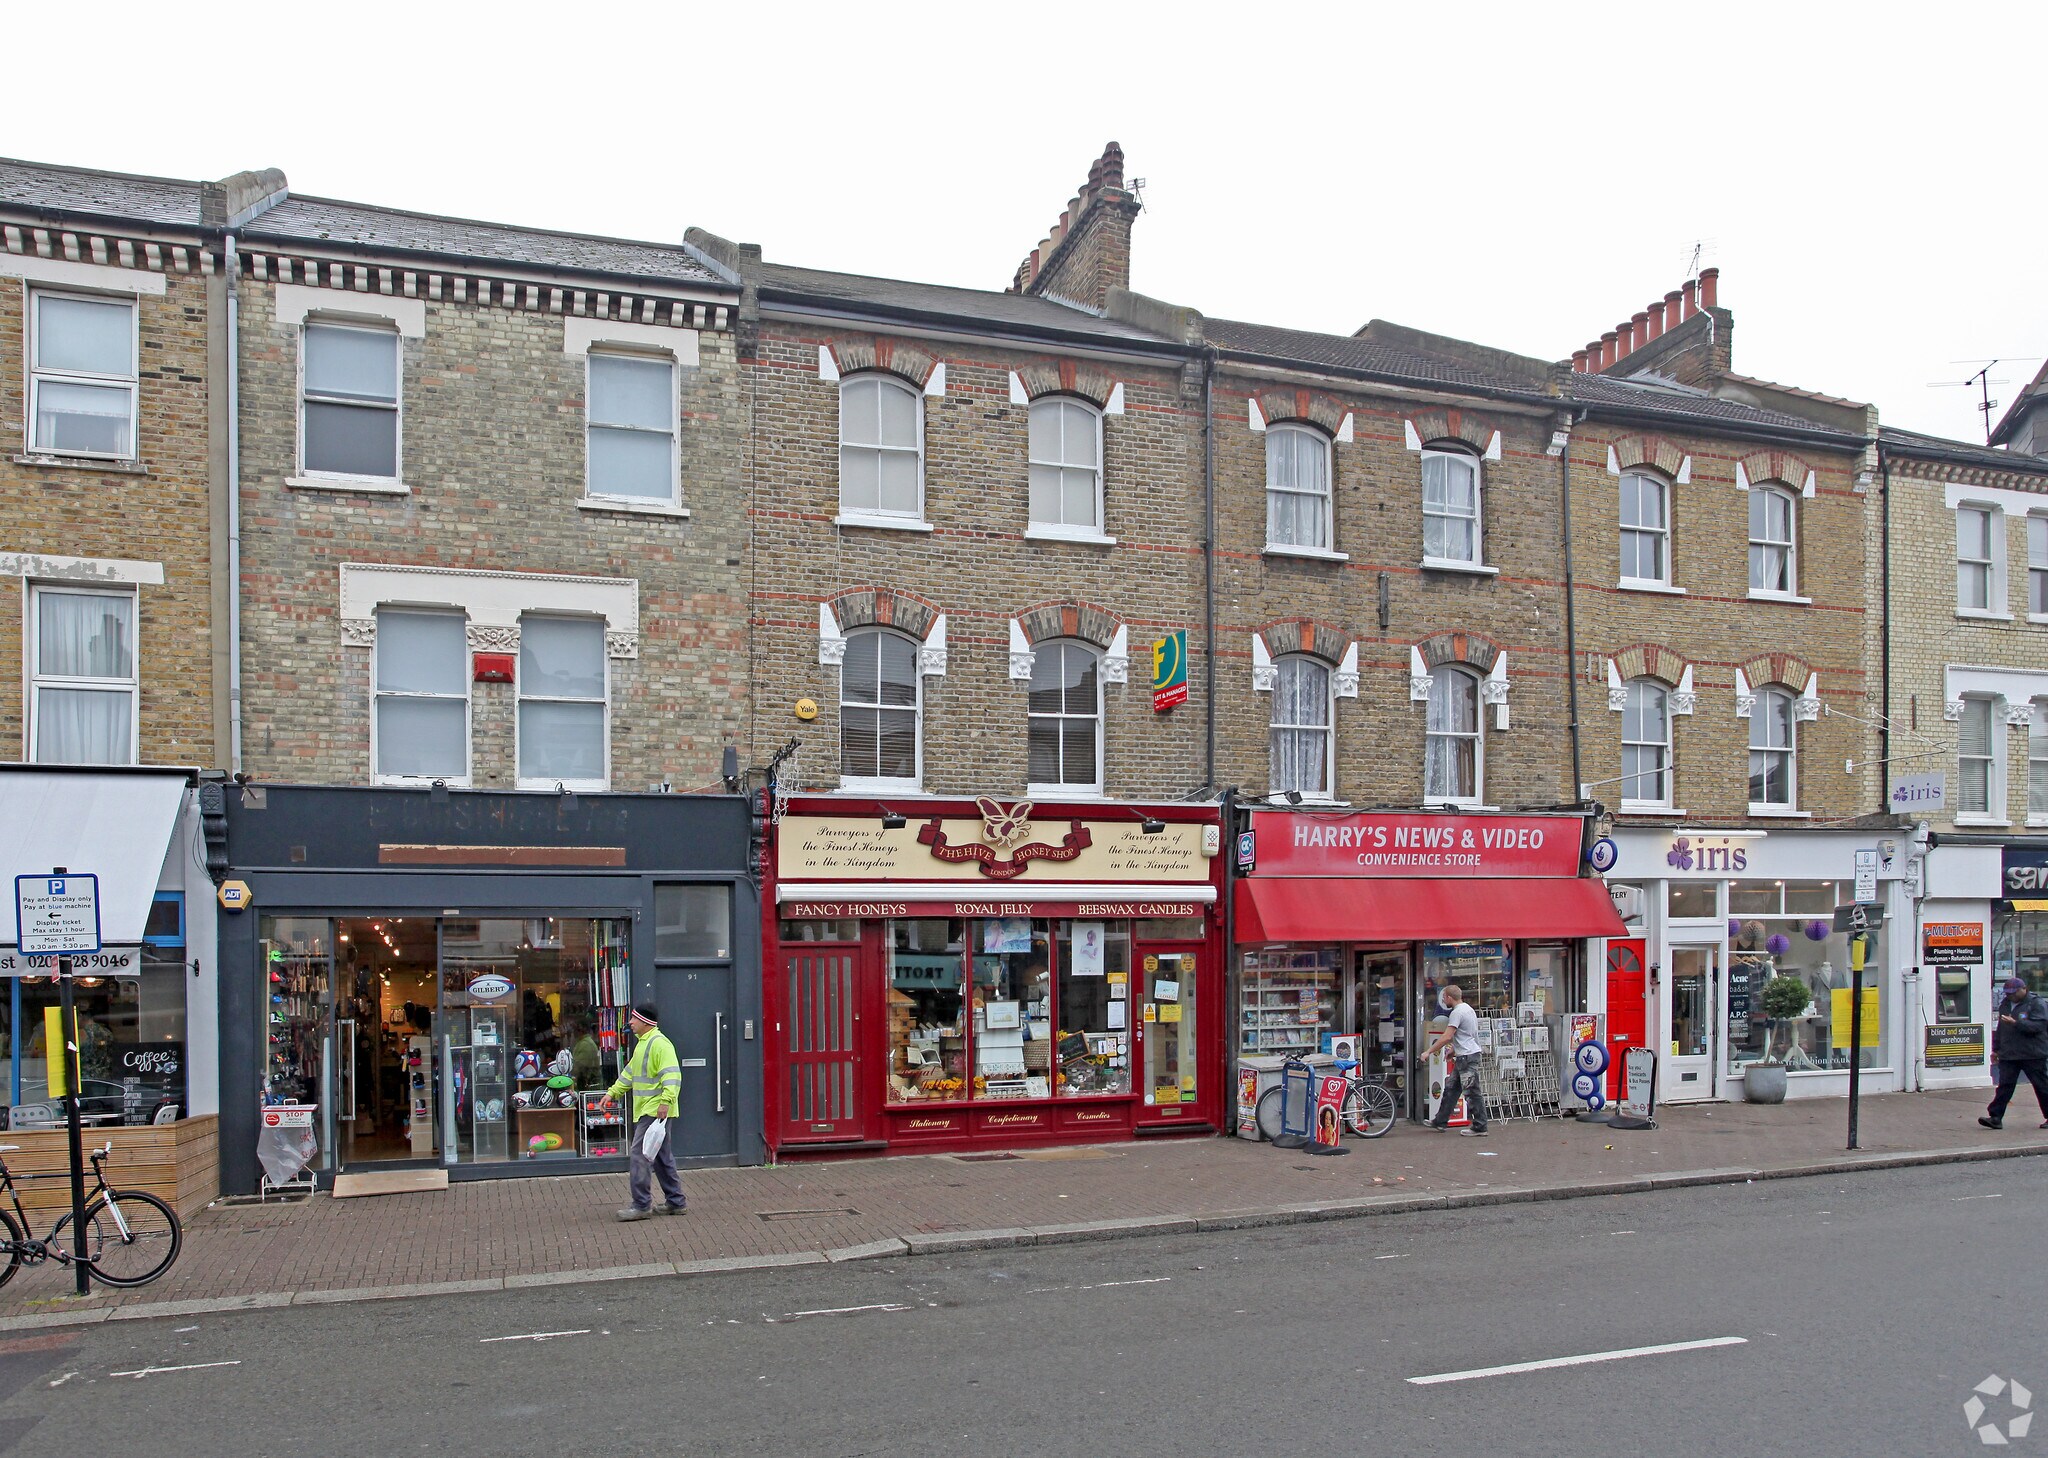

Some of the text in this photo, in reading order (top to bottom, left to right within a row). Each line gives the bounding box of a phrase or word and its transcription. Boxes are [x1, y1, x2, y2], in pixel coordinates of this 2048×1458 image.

[1910, 782, 1941, 801] iris
[816, 826, 887, 841] Purveyors of
[1120, 831, 1184, 844] Purveyors of
[1294, 826, 1544, 849] HARRY'S NEWS & VIDEO
[802, 840, 899, 855] the Finest Honeys
[939, 846, 992, 860] THE HIVE
[1016, 847, 1073, 861] HONEY SHOP
[1108, 845, 1192, 859] the Finest Honeys
[1357, 853, 1481, 865] CONVENIENCE STORE
[1696, 838, 1747, 871] iris
[805, 857, 896, 871] in the Kingdom
[1110, 860, 1189, 873] in the Kingdom
[1882, 863, 1892, 872] 97
[990, 868, 1016, 876] LONDON
[52, 881, 62, 893] P
[795, 904, 907, 916] FANCY HONEYS
[955, 904, 1033, 916] ROYAL JELLY
[1078, 904, 1194, 914] BEESWAX CANDLES
[1478, 946, 1495, 955] Stop
[0, 956, 16, 969] st
[92, 954, 129, 968] 9046
[1730, 974, 1748, 983] Acne
[124, 1051, 170, 1072] Coffee
[988, 1114, 1039, 1125] Confectionary
[1076, 1112, 1110, 1120] Cosmetics
[909, 1119, 950, 1128] Stationary
